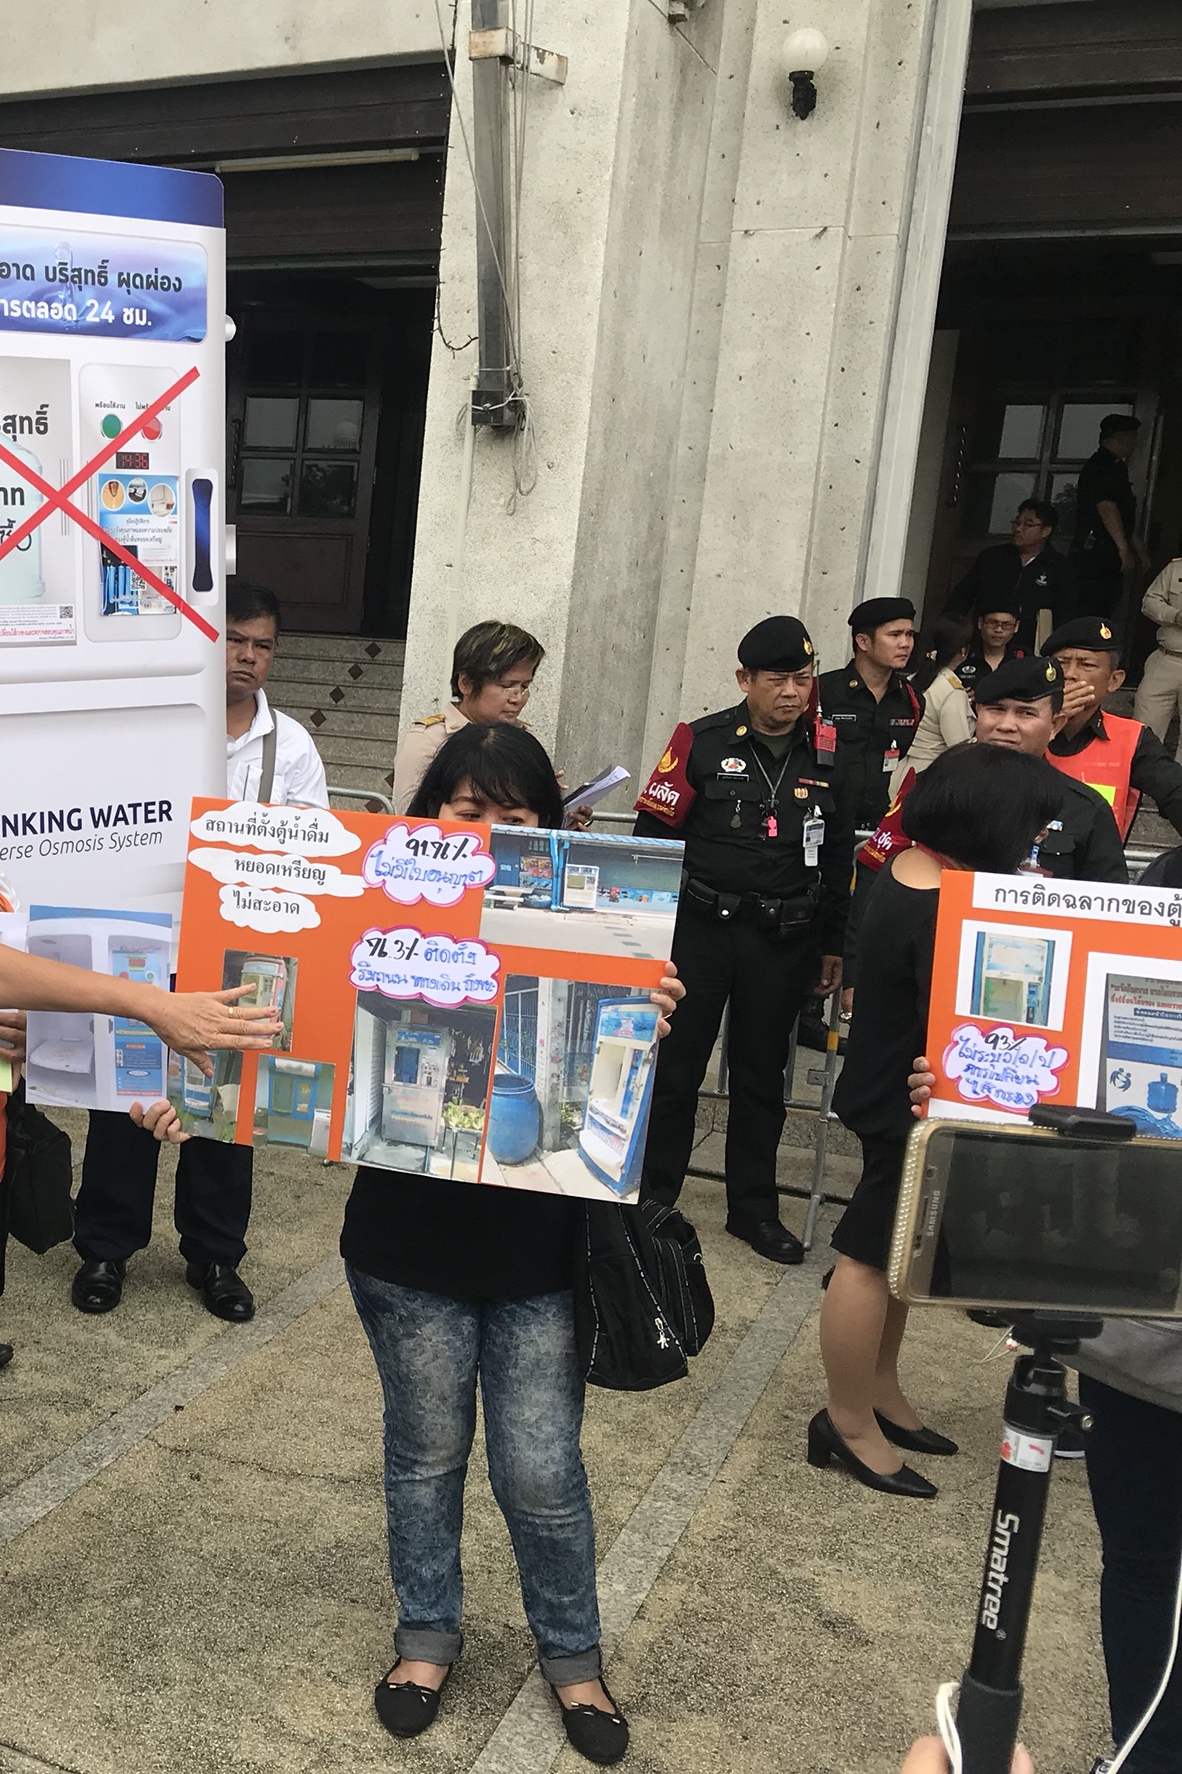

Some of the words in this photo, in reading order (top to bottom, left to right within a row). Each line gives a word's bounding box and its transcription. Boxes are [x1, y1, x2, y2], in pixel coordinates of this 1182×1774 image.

[45, 259, 109, 291] บริสุทธิ์
[117, 268, 183, 295] ผุดผ่อง
[85, 299, 115, 323] 24
[122, 306, 153, 326] ชม.
[90, 799, 173, 829] WATER
[205, 812, 329, 844] สถานที่ตั้งตู้น้ำดื่ม
[38, 834, 105, 857] Osmosis
[109, 828, 163, 852] System
[234, 858, 326, 886] หยอดเหรียญ
[232, 889, 300, 915] ไม่สะอาด
[994, 883, 1182, 927] การติดฉลากของตู้
[984, 1033, 1027, 1051] 93%
[927, 1190, 940, 1237] SAMSUNG
[982, 1509, 1020, 1630] Smatree
